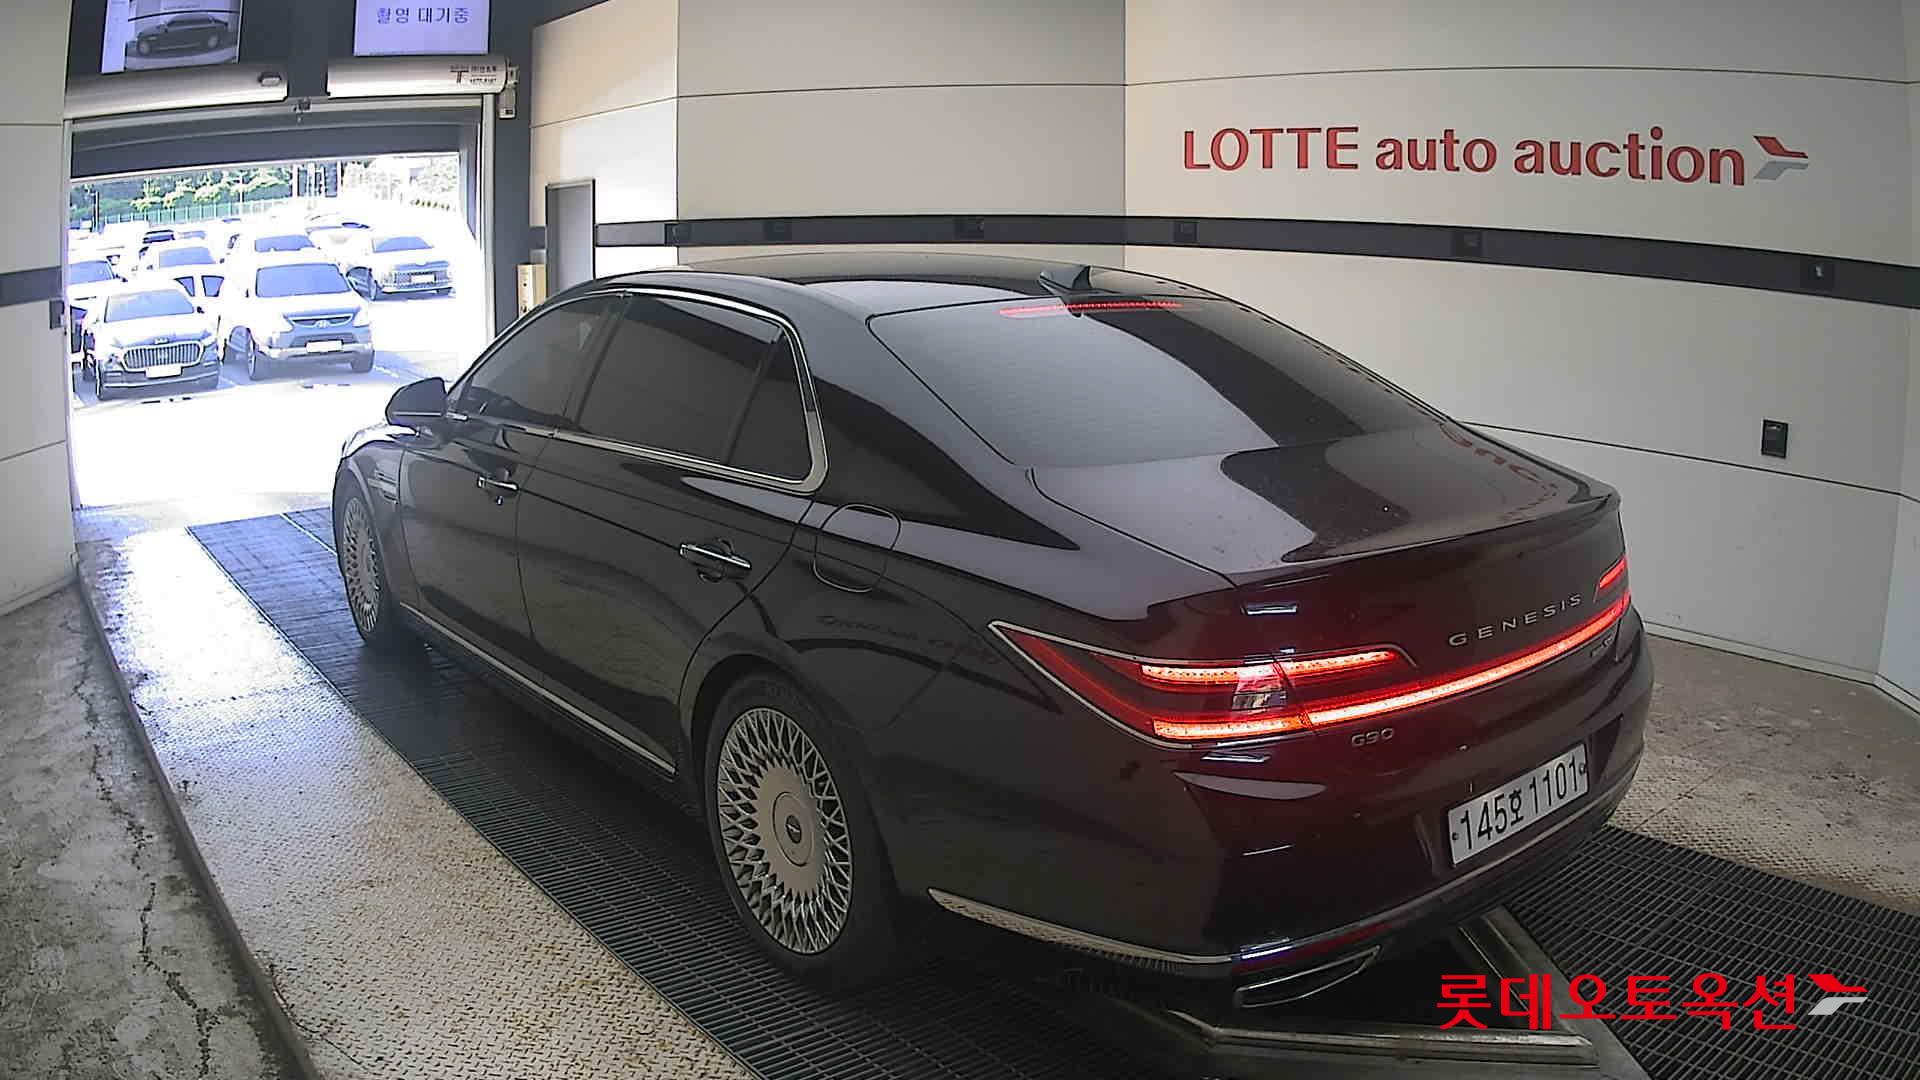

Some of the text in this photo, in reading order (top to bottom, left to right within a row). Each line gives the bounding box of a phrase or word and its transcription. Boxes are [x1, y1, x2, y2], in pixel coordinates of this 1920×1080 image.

[418, 7, 470, 24] 대기중
[1183, 126, 1745, 186] LOTTE auto auction
[1448, 593, 1583, 648] GENESIS
[1351, 727, 1395, 748] G90
